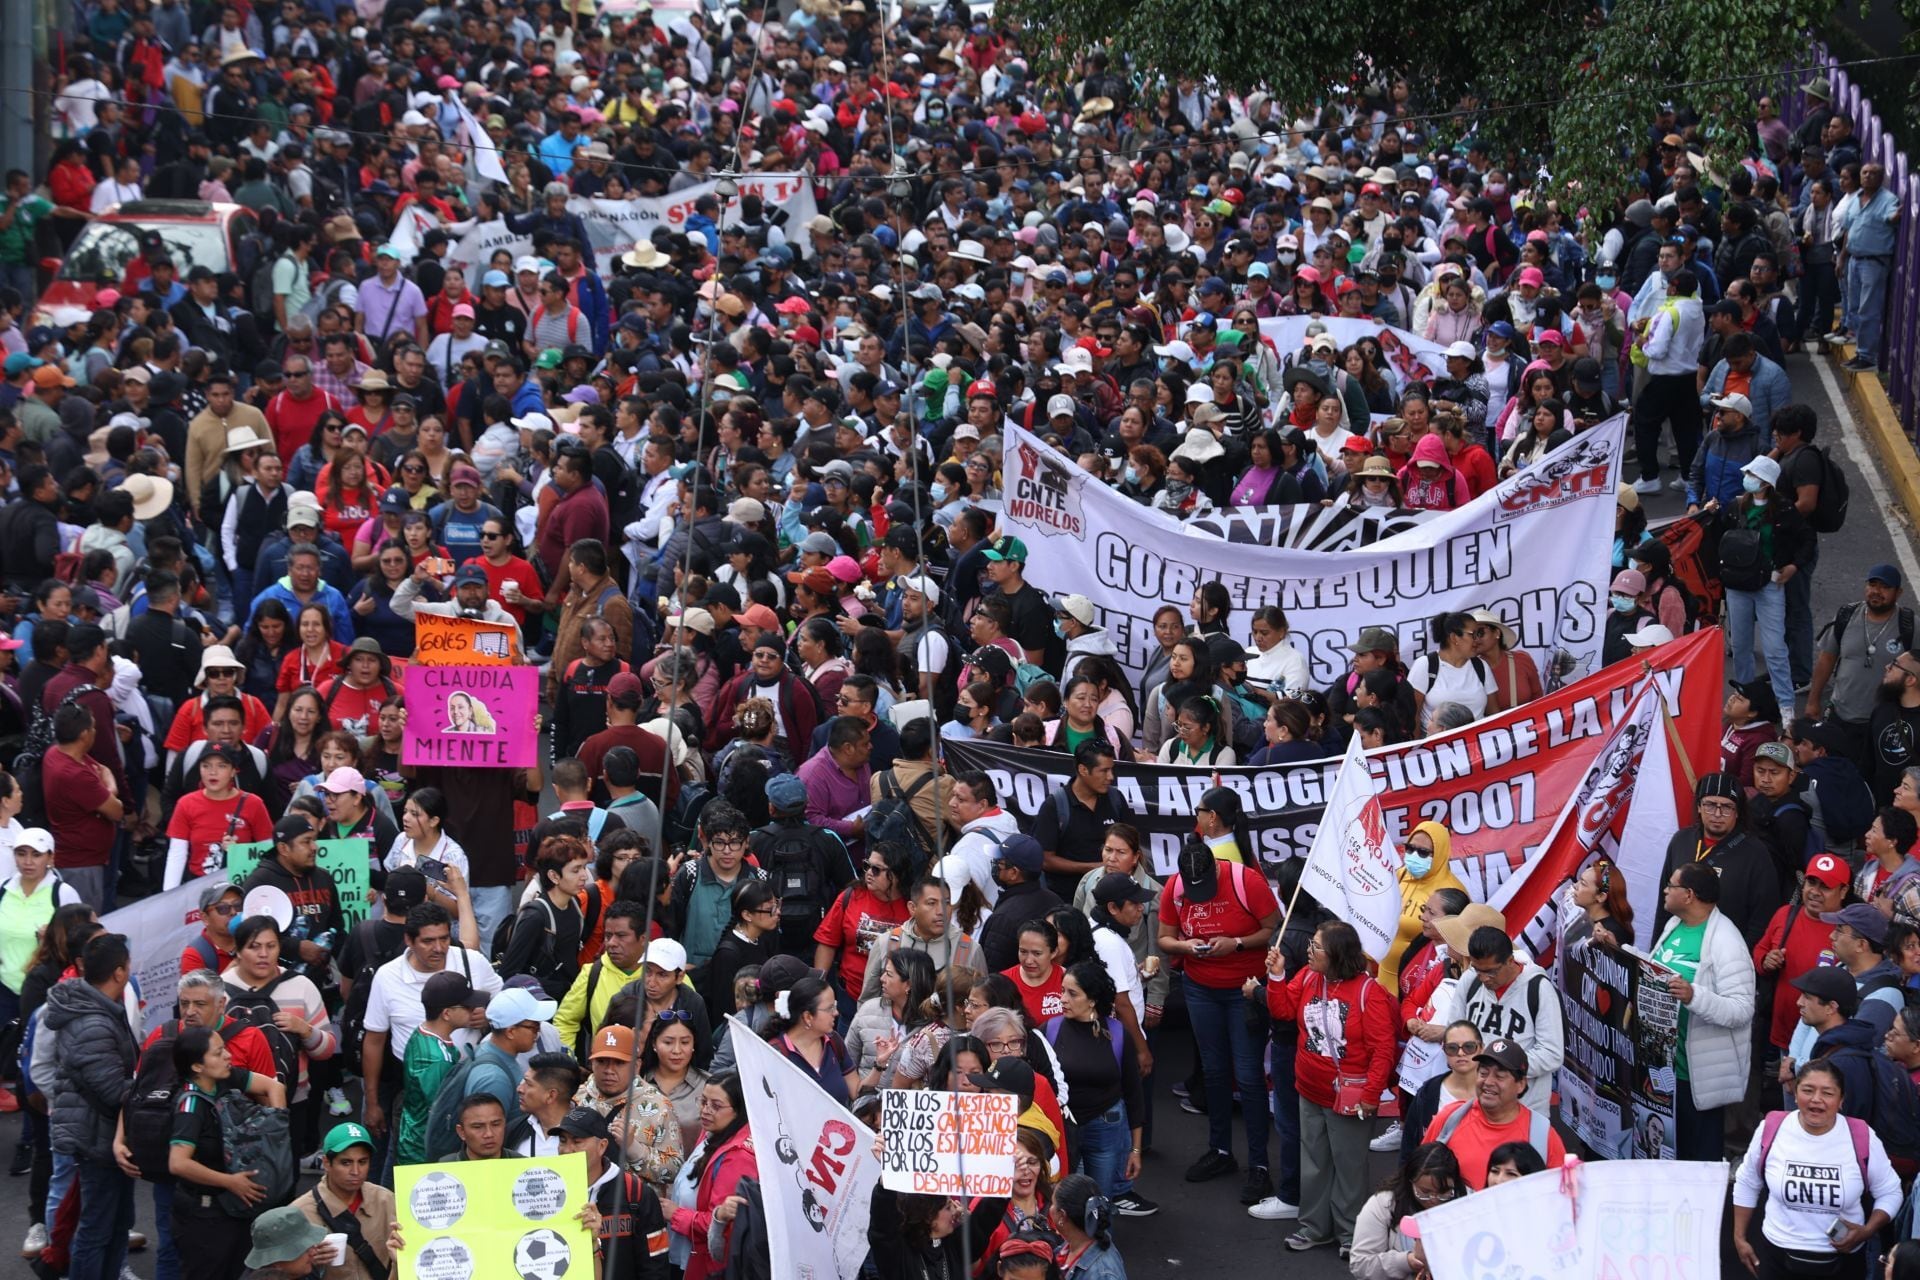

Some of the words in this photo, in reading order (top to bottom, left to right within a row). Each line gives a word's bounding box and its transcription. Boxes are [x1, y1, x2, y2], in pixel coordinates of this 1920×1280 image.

[1017, 478, 1067, 511] CNTE
[1502, 465, 1610, 512] CNTE
[1010, 499, 1080, 534] MORELOS
[1357, 524, 1513, 609] QUIEN
[420, 632, 468, 651] GOLES
[424, 669, 515, 691] CLAUDIA
[1479, 719, 1539, 770] DE
[1546, 696, 1604, 749] LA
[415, 737, 510, 764] MIENTE
[1421, 771, 1537, 836] 2007
[1467, 1001, 1526, 1041] GAP
[886, 1091, 908, 1110] POR
[915, 1091, 941, 1112] LOS
[947, 1094, 1012, 1115] MAESTROS
[883, 1109, 908, 1129] POR
[910, 1111, 935, 1131] LOS
[883, 1129, 904, 1152] POR
[908, 1132, 933, 1152] LOS
[882, 1151, 909, 1172] POR
[913, 1150, 939, 1173] LOS
[1814, 1168, 1838, 1179] SOY
[914, 1172, 1014, 1195] DESAPARECIDOS
[1784, 1180, 1841, 1208] CNTE
